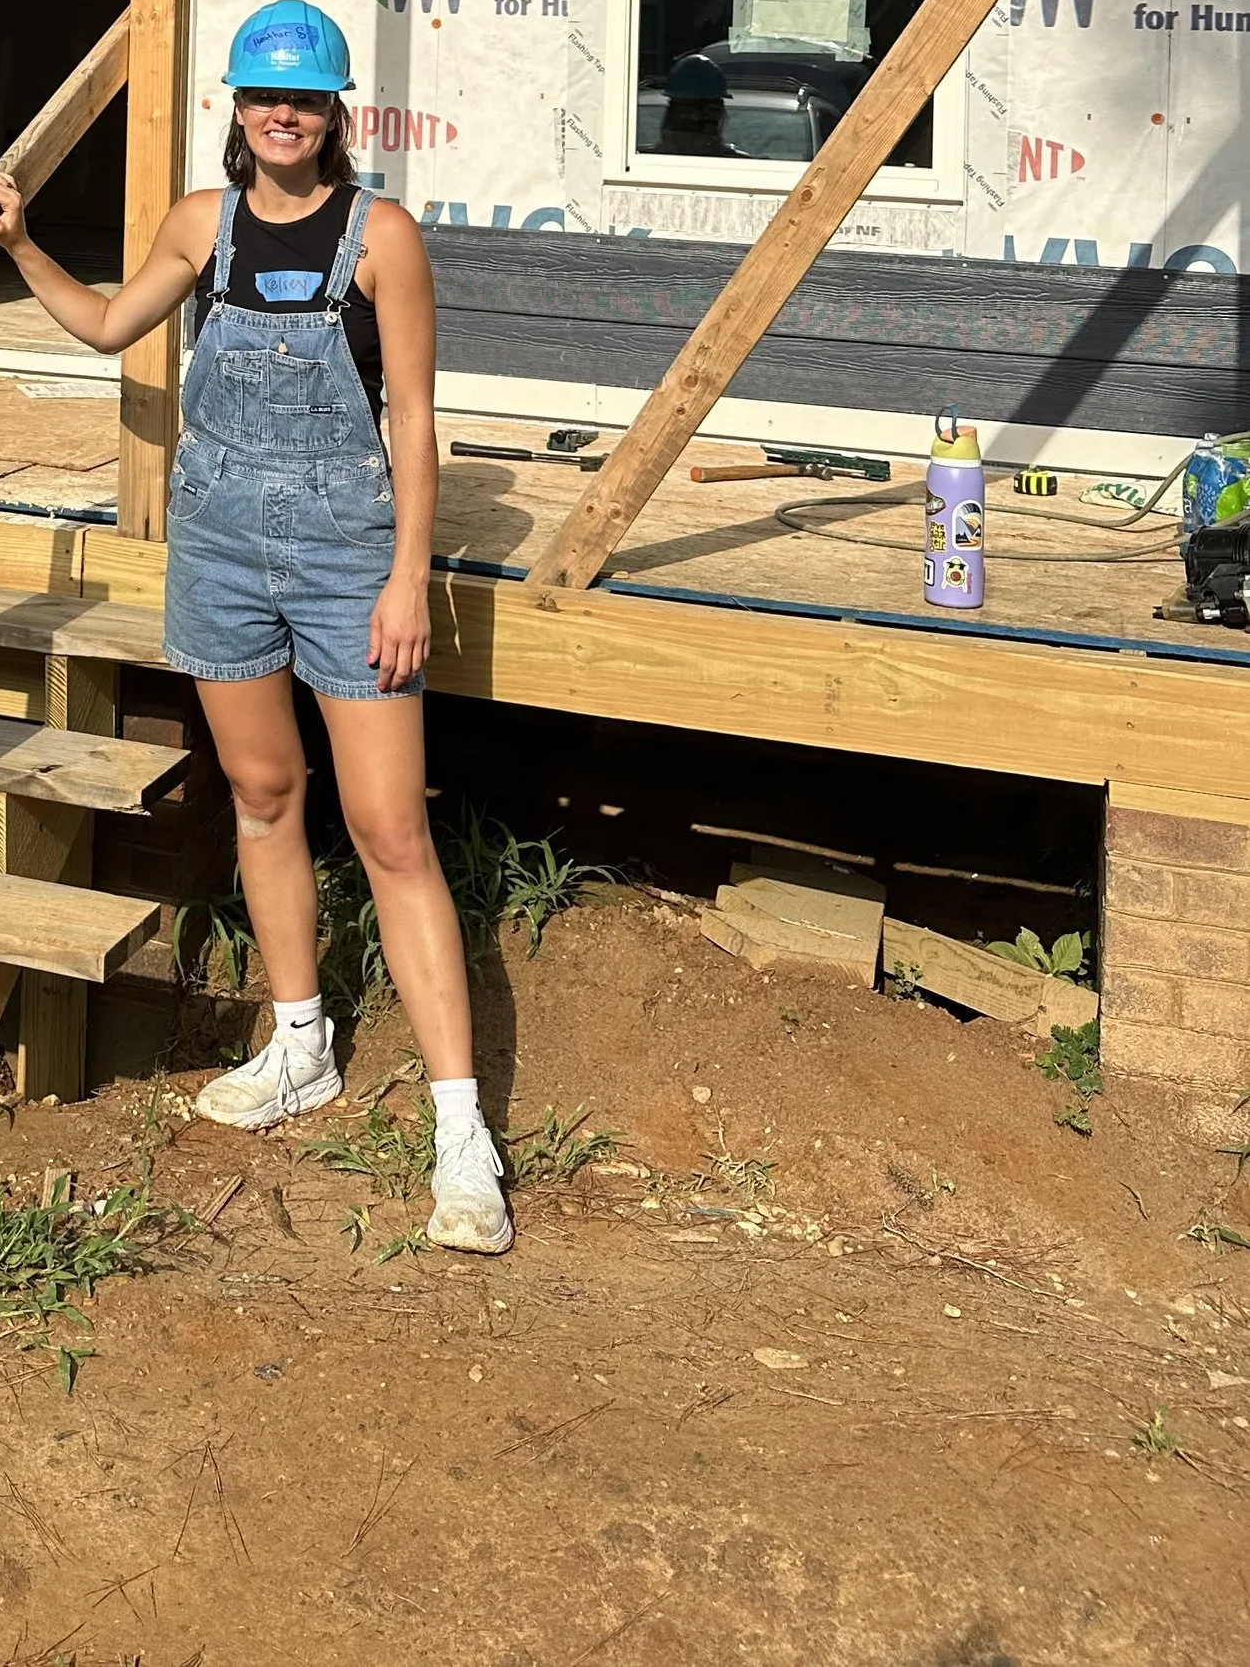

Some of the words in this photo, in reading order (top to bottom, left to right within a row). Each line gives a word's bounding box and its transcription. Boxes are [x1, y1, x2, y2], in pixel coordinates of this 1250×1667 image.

[1133, 3, 1179, 30] for
[295, 26, 307, 40] S
[568, 33, 594, 62] Flashing
[977, 83, 1008, 115] Flashing
[566, 118, 593, 147] Flashing
[975, 175, 1005, 207] Flashing
[565, 203, 592, 233] Flashing
[264, 275, 307, 297] Kelsey
